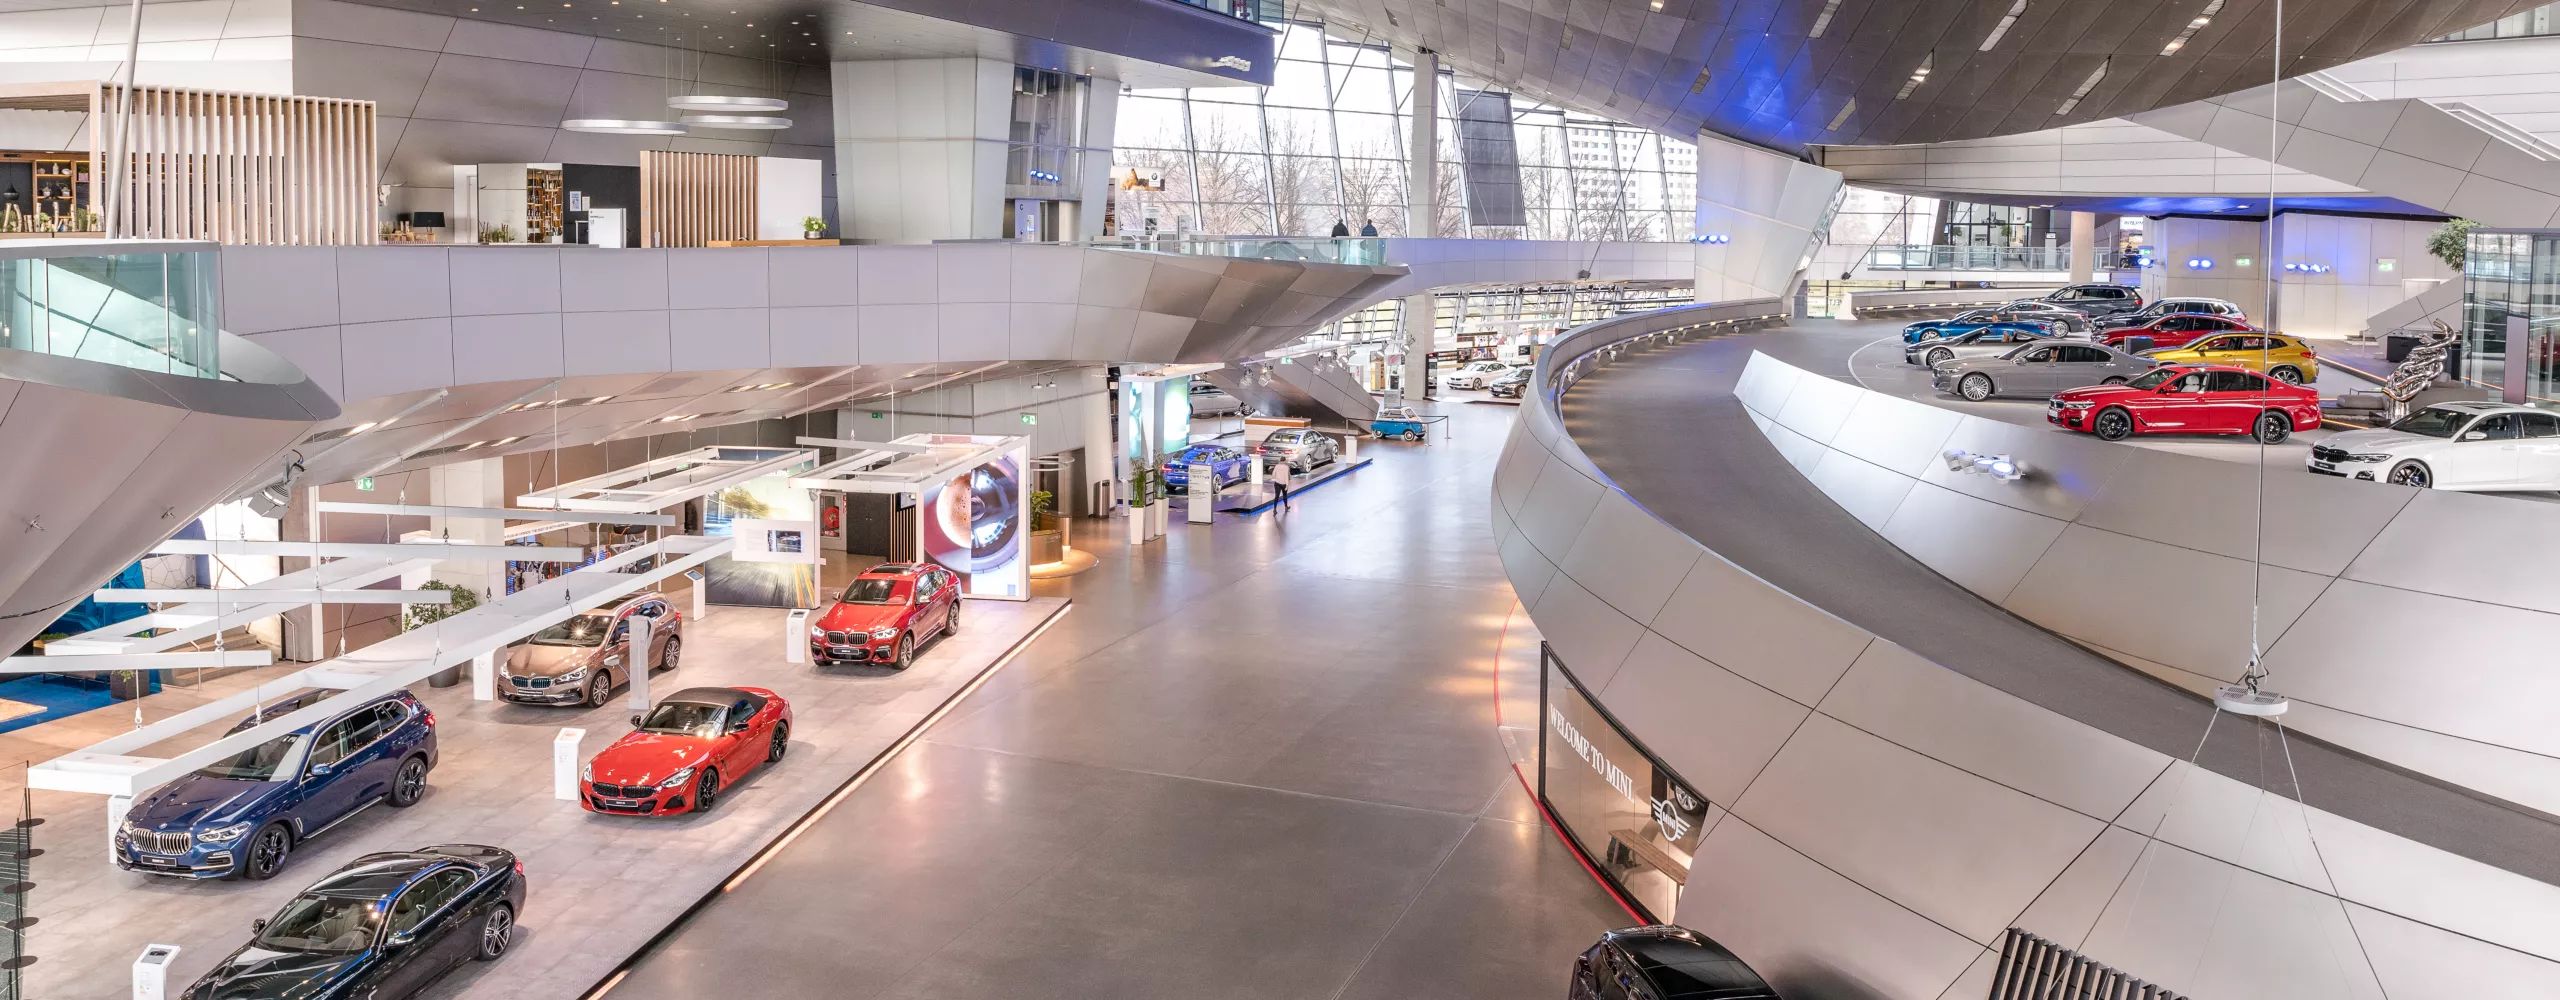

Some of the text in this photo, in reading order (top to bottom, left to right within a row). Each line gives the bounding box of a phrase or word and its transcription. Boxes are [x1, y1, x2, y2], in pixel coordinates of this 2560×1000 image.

[1550, 703, 1590, 763] WELCOME
[1591, 744, 1605, 775] TO
[1662, 811, 1676, 830] MINI
